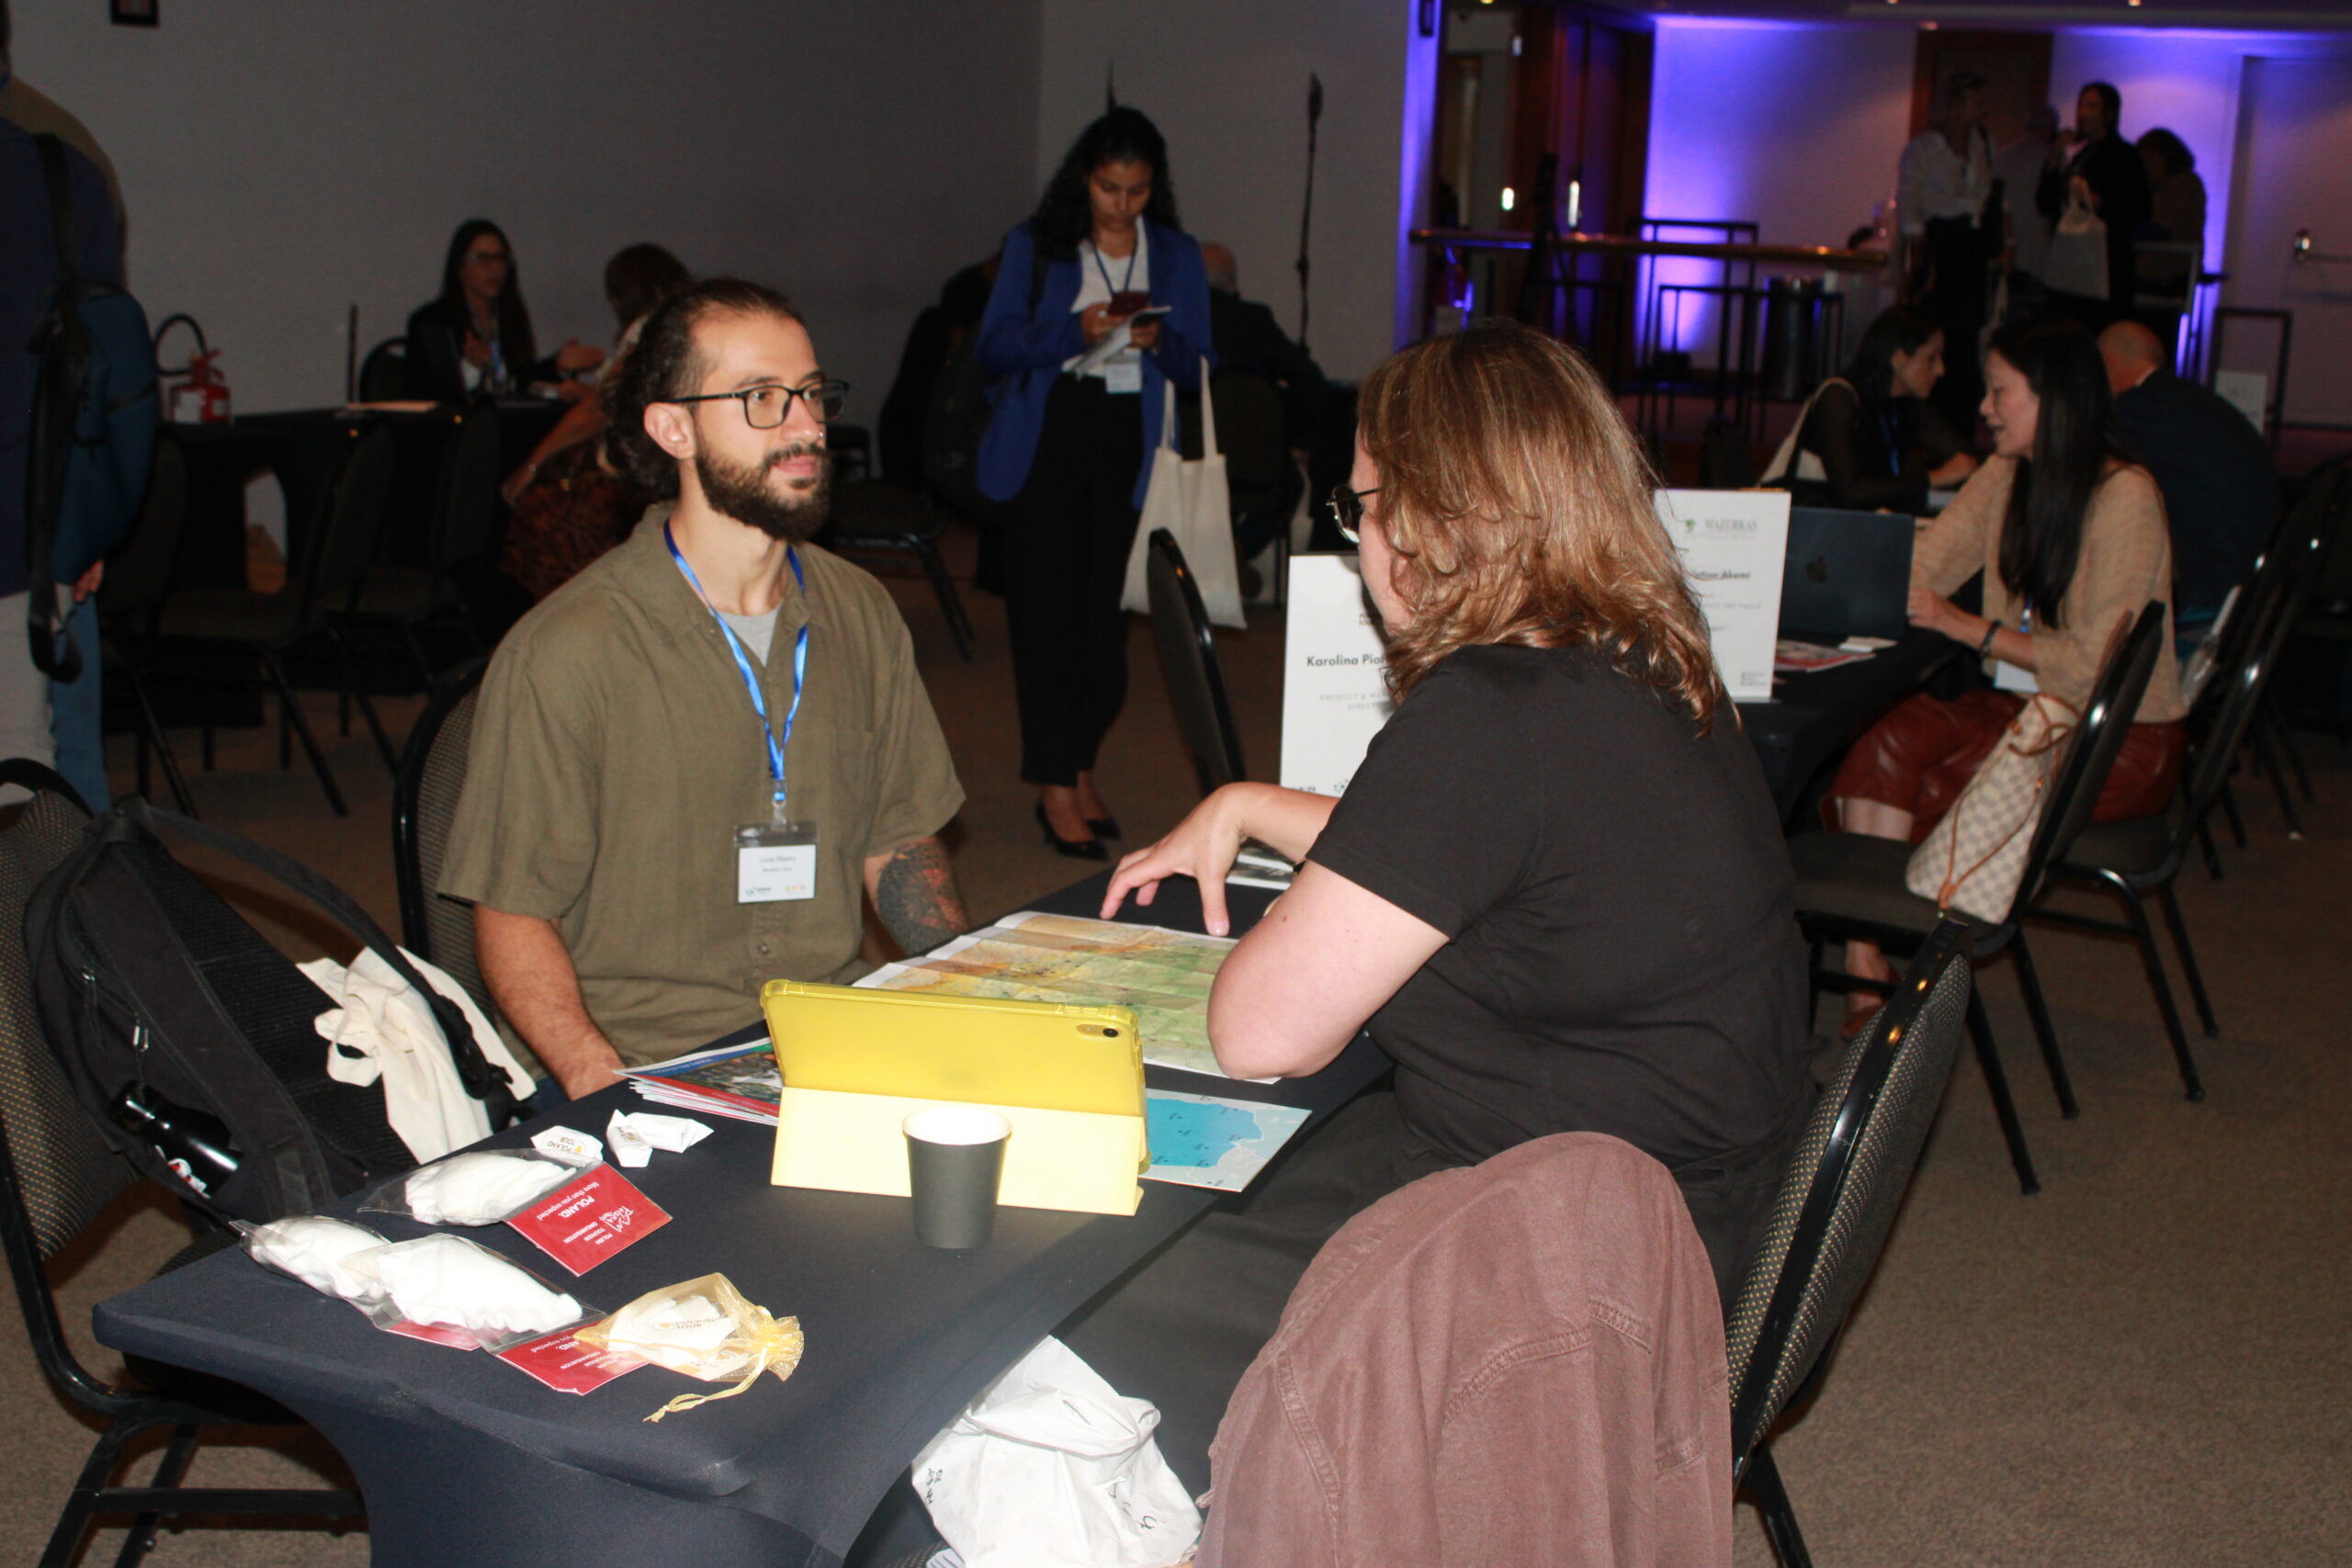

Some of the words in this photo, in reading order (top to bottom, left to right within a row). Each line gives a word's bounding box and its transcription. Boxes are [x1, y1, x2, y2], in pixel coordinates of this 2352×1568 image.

[1306, 654, 1359, 667] Karolina
[1319, 692, 1359, 702] PRODUCT
[547, 1140, 573, 1153] POLAND
[583, 1181, 600, 1192] More
[560, 1195, 573, 1205] you
[571, 1190, 586, 1200] than
[536, 1202, 562, 1222] expected
[558, 1195, 595, 1218] POLAND.
